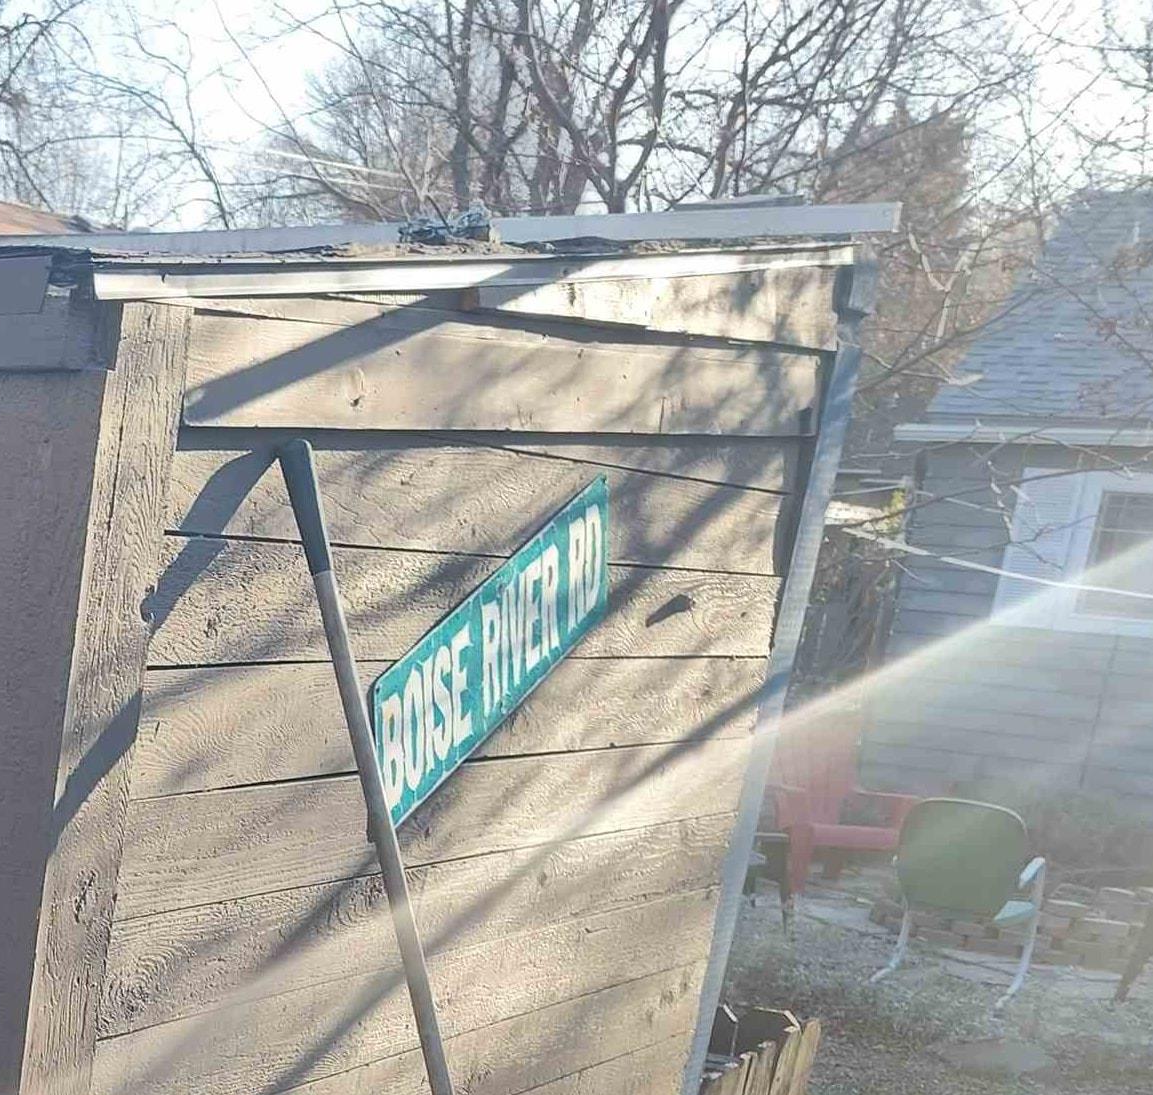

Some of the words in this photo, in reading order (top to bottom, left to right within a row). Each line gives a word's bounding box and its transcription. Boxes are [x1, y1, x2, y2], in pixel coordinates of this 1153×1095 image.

[381, 624, 475, 803] BOISE
[481, 544, 560, 717] RIVER
[567, 503, 602, 630] RD
